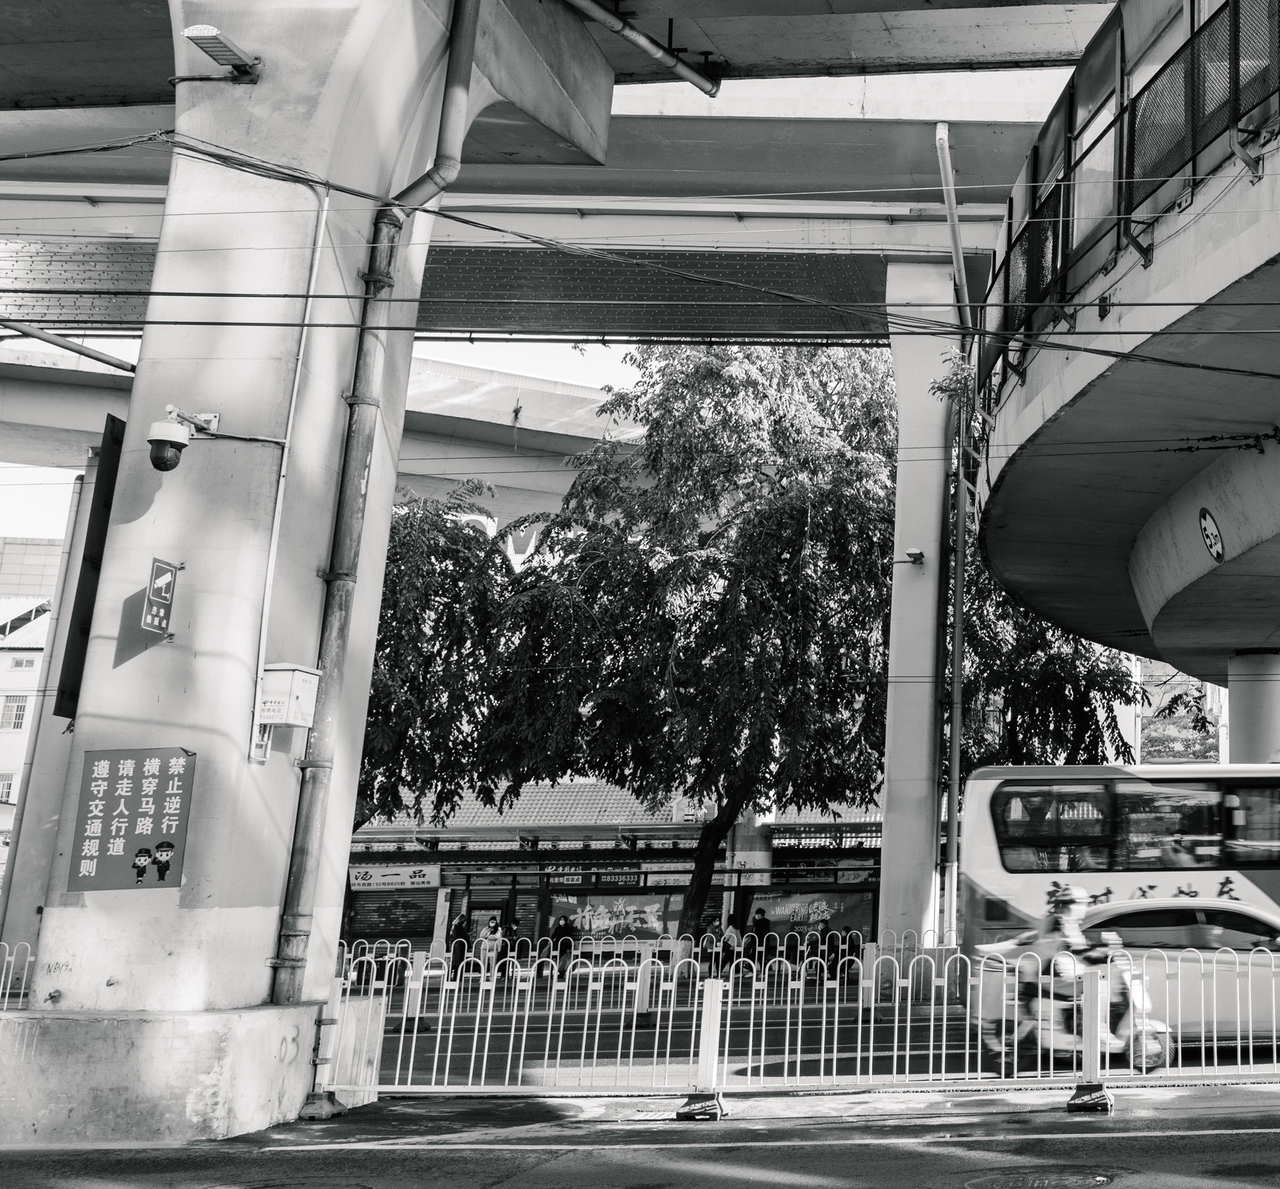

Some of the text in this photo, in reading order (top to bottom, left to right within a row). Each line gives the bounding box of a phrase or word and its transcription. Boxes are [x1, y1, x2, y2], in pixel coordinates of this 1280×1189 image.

[79, 760, 111, 877] 遵守交通规则
[107, 759, 136, 856] 请走人行道
[135, 758, 161, 835] 横穿马路
[161, 757, 186, 834] 禁止逆行
[355, 869, 427, 881] 汤一品
[606, 874, 638, 882] 83336333
